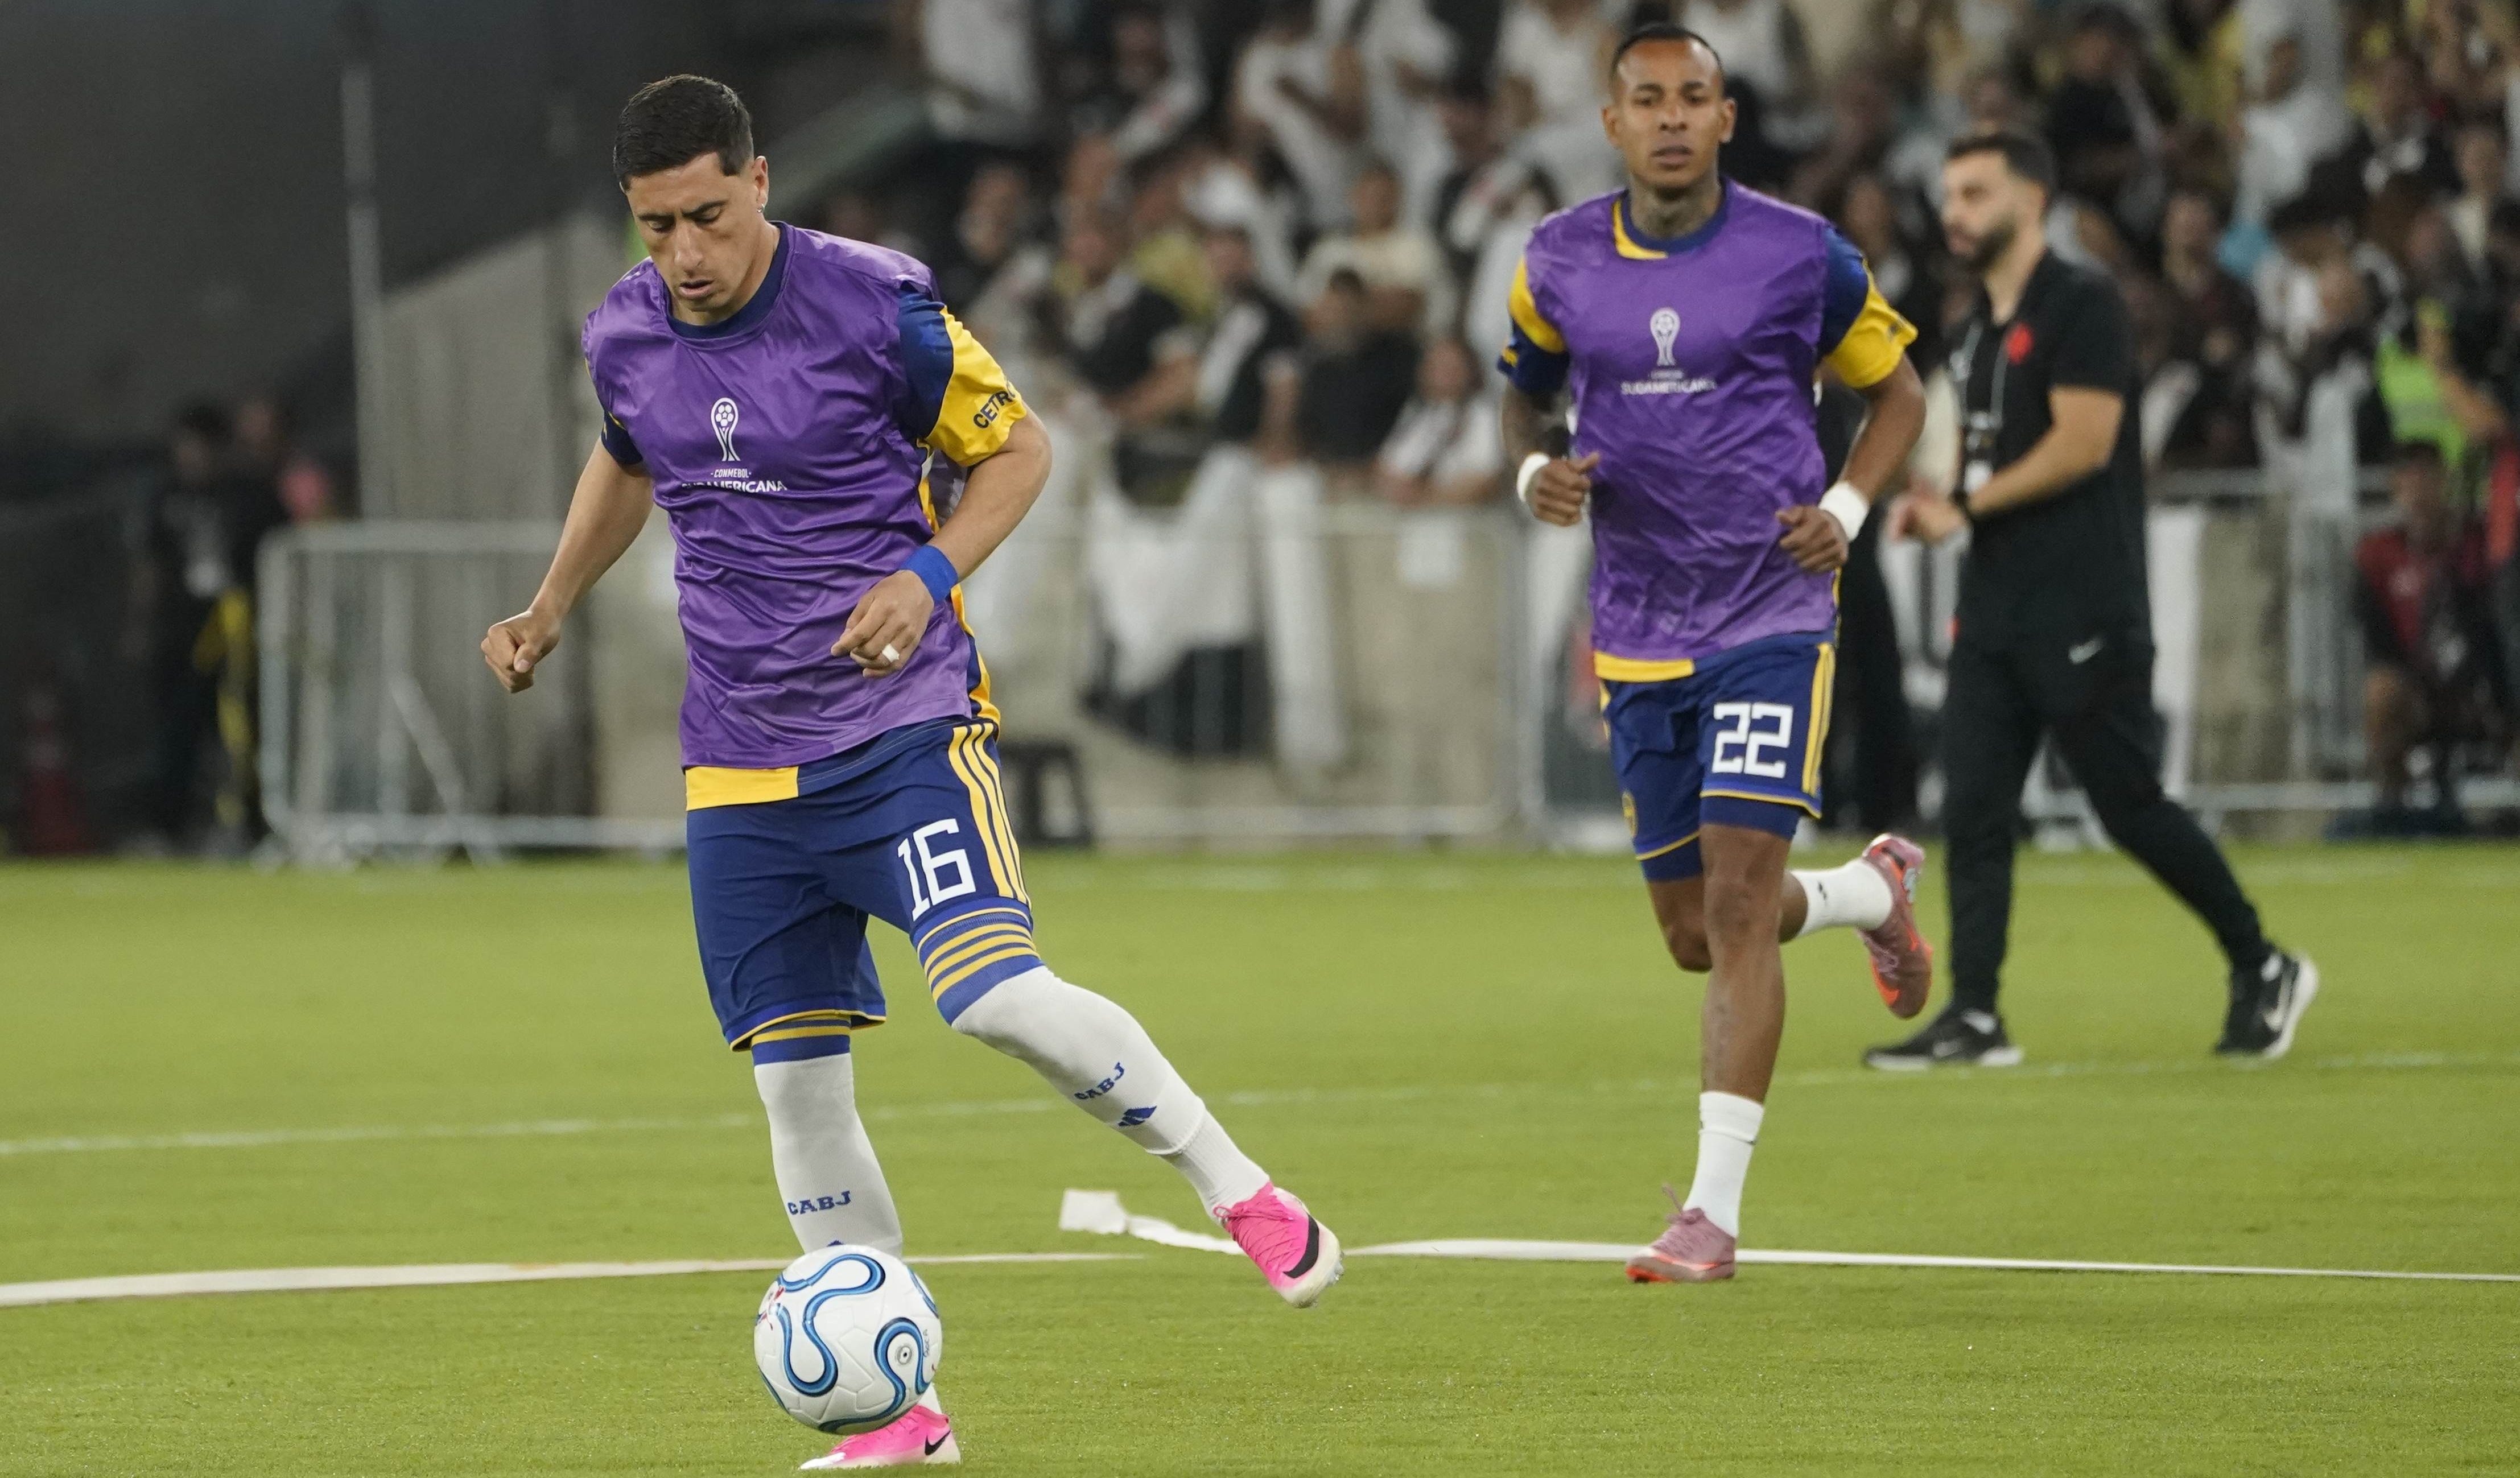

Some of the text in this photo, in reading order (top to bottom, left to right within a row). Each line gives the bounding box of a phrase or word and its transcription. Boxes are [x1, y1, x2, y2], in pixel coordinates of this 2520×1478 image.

[1711, 702, 1793, 779] 22
[898, 818, 976, 922] 16
[1074, 1062, 1124, 1100] CABJ
[787, 1190, 851, 1215] CABJ
